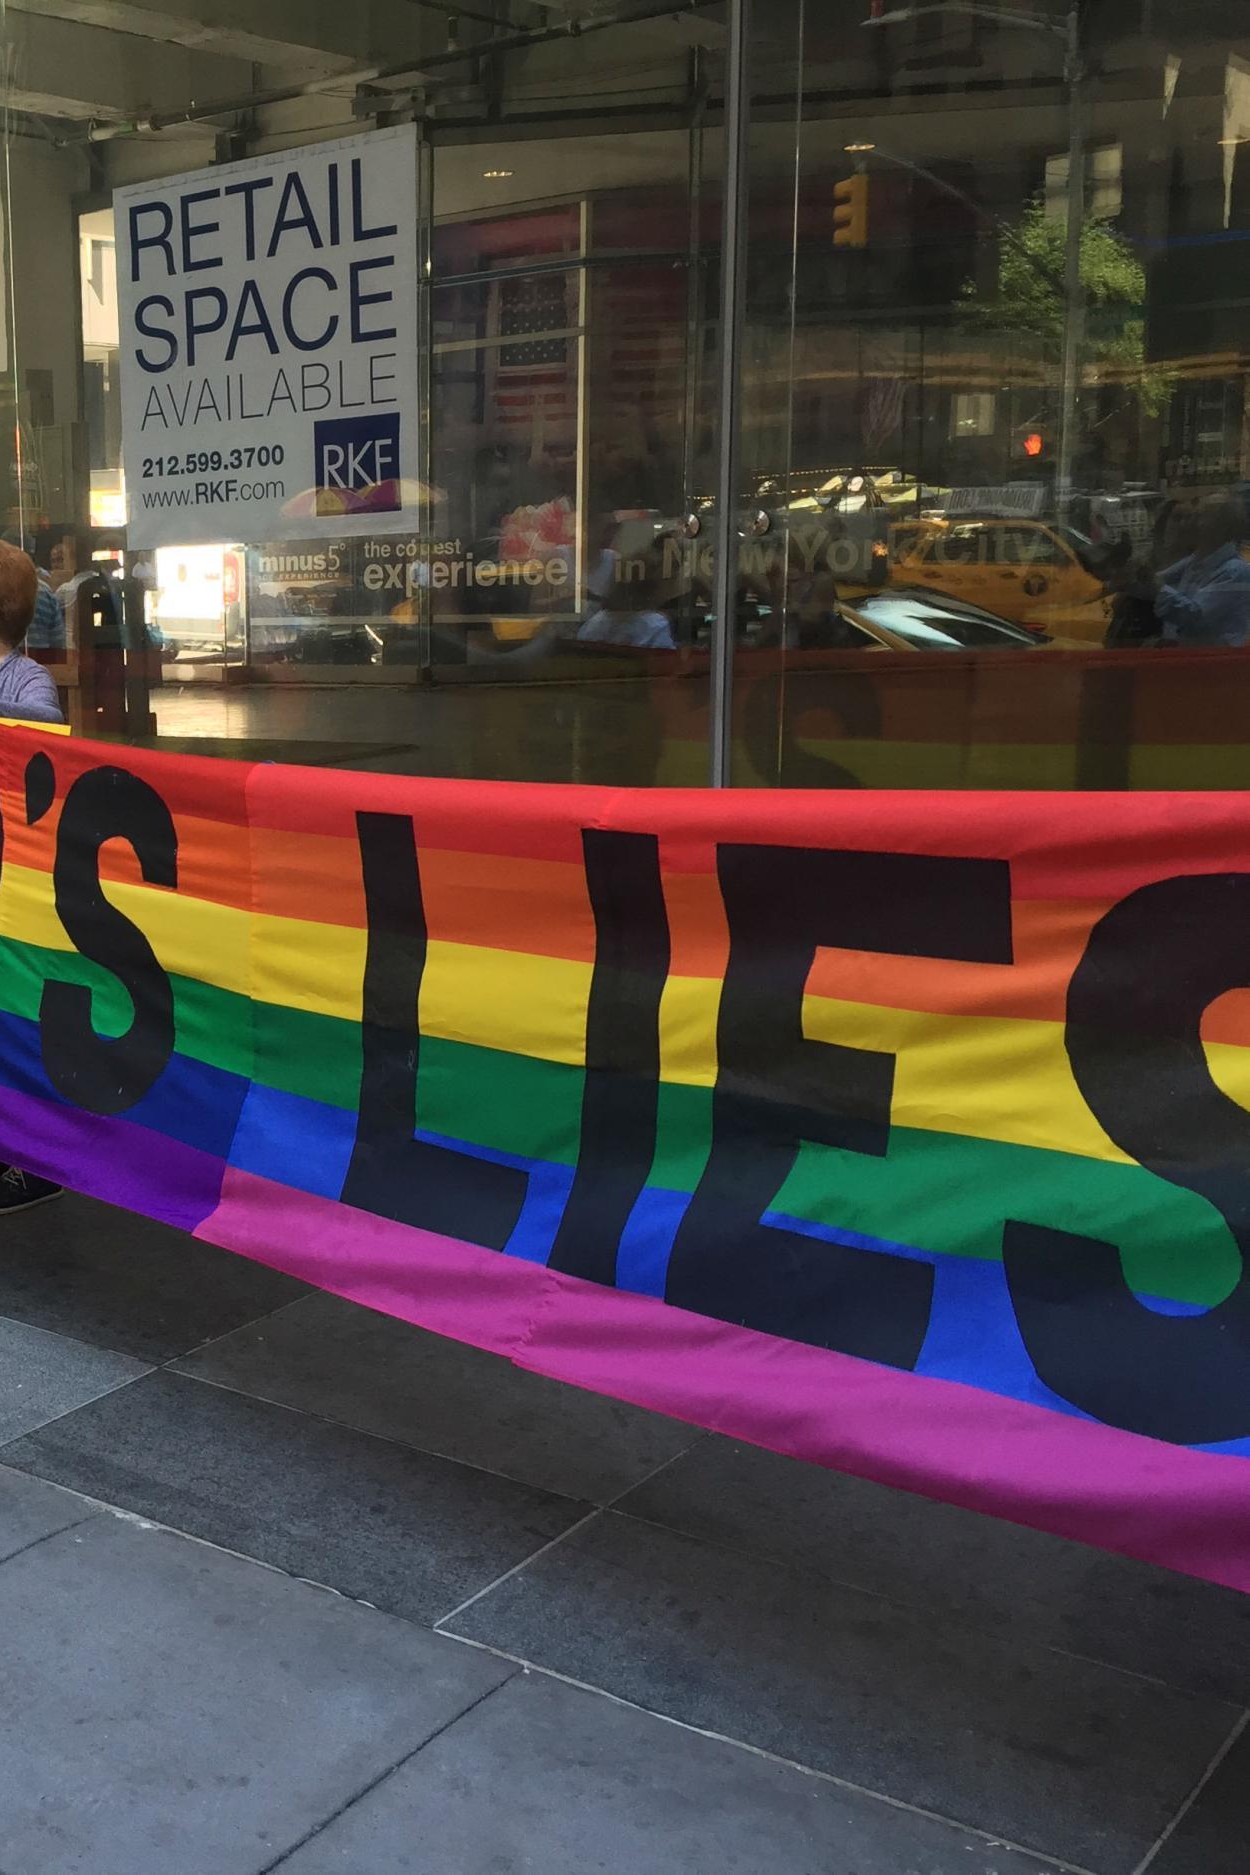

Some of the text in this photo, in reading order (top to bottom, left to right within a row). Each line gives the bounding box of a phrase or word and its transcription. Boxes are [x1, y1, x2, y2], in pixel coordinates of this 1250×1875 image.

[129, 158, 398, 282] RETAIL
[135, 255, 397, 373] SPACE
[141, 353, 398, 431] AVAILABLE
[142, 445, 285, 478] 212.599.3700
[323, 438, 393, 490] RKF
[142, 479, 285, 508] www.RKF.com
[363, 552, 569, 597] experience
[364, 538, 462, 558] the coest
[614, 524, 1042, 584] in New York City
[340, 811, 1250, 1444] LIES
